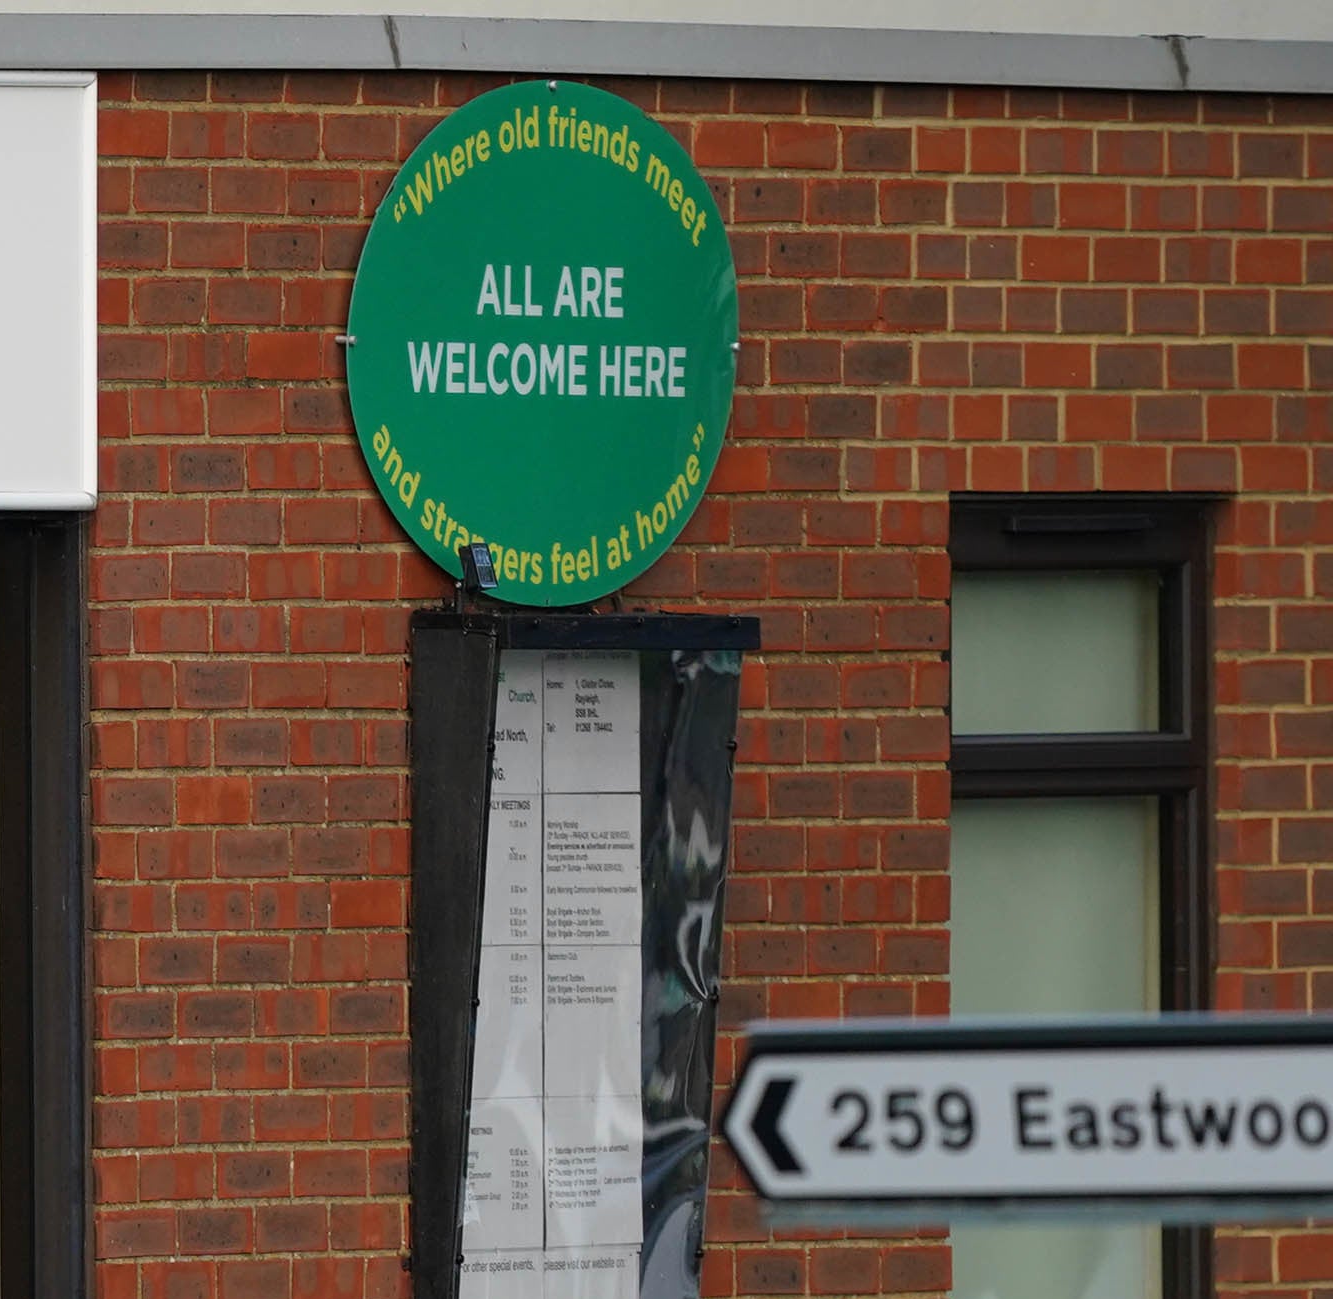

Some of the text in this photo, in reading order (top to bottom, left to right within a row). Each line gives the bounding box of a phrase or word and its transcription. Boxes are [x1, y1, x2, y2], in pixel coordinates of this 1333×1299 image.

[499, 105, 539, 153] old
[548, 105, 640, 172] friends
[645, 153, 706, 247] meet
[476, 264, 624, 318] ALL ARE
[407, 341, 687, 397] WELCOME HERE
[373, 424, 421, 508] and
[420, 498, 542, 585] stragers
[550, 536, 598, 585] feel
[607, 525, 632, 570] at
[831, 1085, 1331, 1153] 259 Eastwoo
